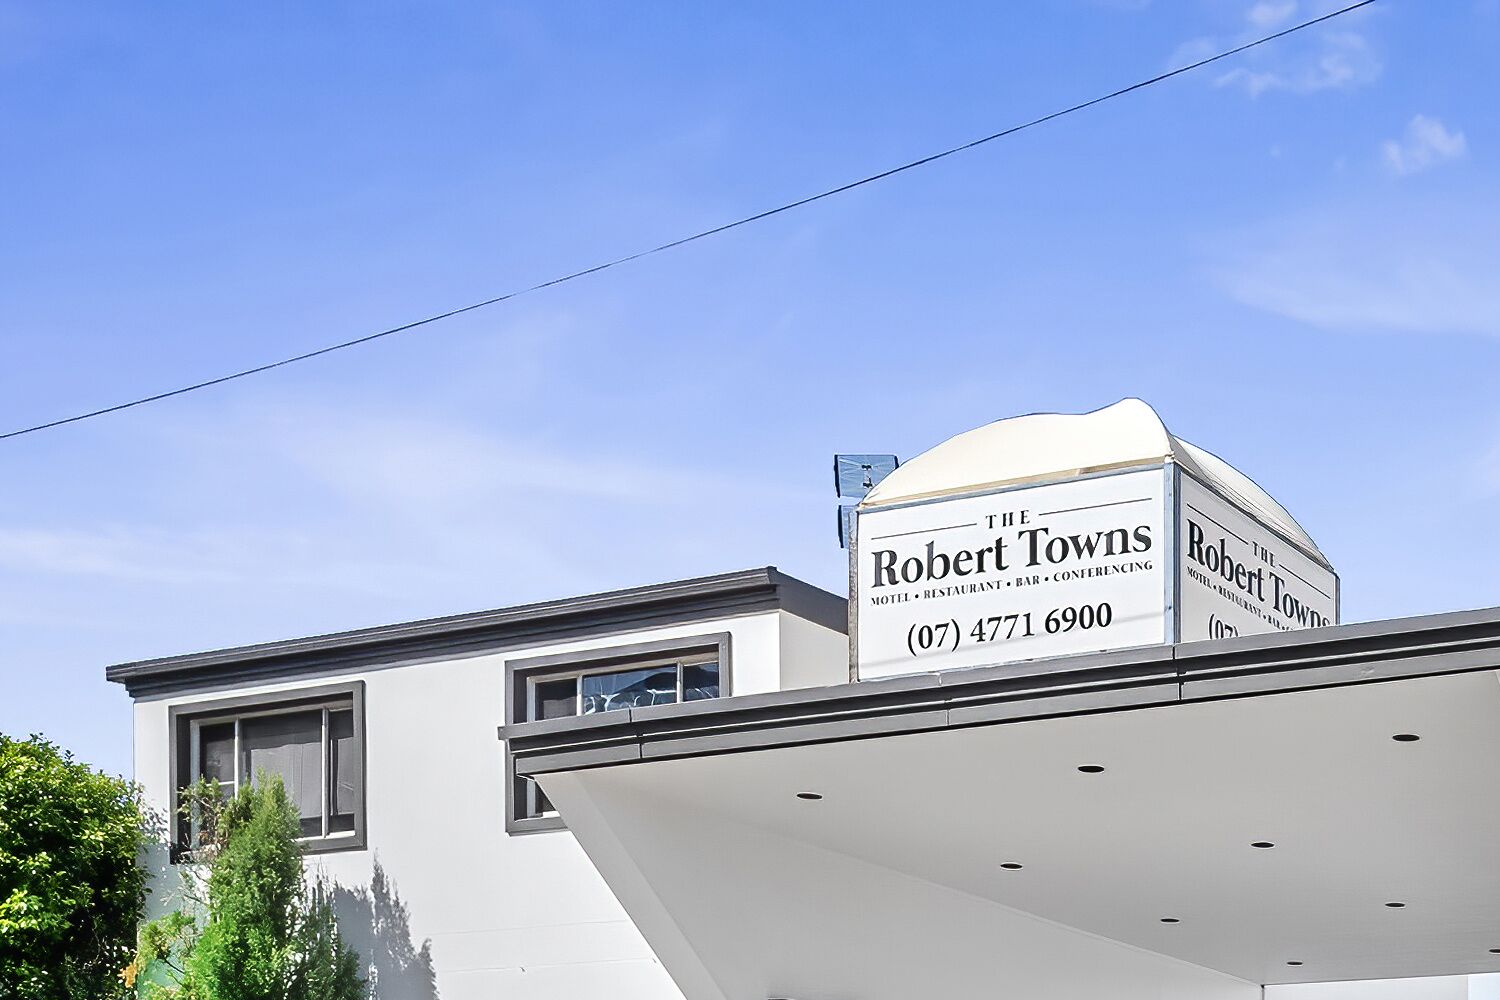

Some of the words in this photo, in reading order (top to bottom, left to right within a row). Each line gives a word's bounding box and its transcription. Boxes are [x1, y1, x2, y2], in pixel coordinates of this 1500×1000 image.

[985, 510, 1030, 529] THE
[871, 536, 1009, 588] Robert
[1018, 525, 1152, 567] Towns
[1186, 518, 1265, 602] Robert
[1252, 541, 1276, 567] THE
[871, 592, 911, 606] MOTEL
[923, 580, 1003, 599] RESTAURANT
[1016, 575, 1040, 587] BAR
[1053, 560, 1153, 582] CONFERENCING
[1187, 566, 1212, 590] MOTEL
[907, 618, 960, 657] (07)
[970, 611, 1035, 643] 4771
[1044, 602, 1112, 634] 6900
